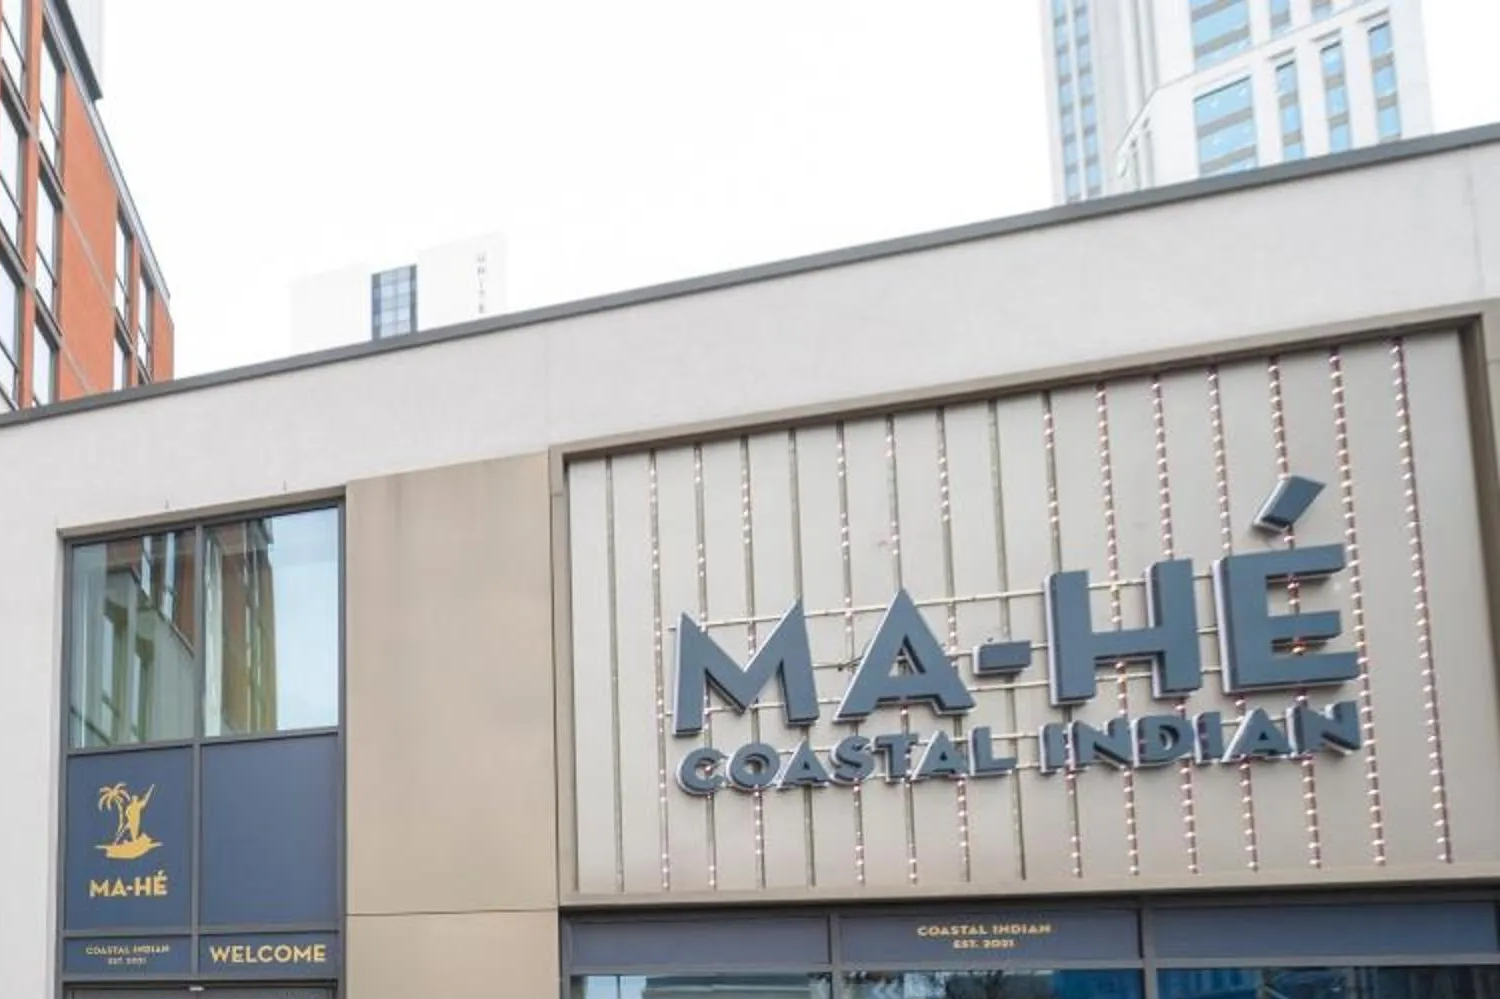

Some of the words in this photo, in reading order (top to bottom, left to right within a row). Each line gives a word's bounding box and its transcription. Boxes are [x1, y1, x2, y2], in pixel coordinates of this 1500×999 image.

[672, 475, 1362, 738] MA-HÉ
[675, 725, 1017, 797] COASTAL
[1039, 701, 1362, 775] INDIAN
[89, 869, 168, 898] MA-HÉ
[916, 924, 988, 936] COASTAL
[992, 923, 1052, 935] INDIAN
[209, 943, 327, 964] WELCOME
